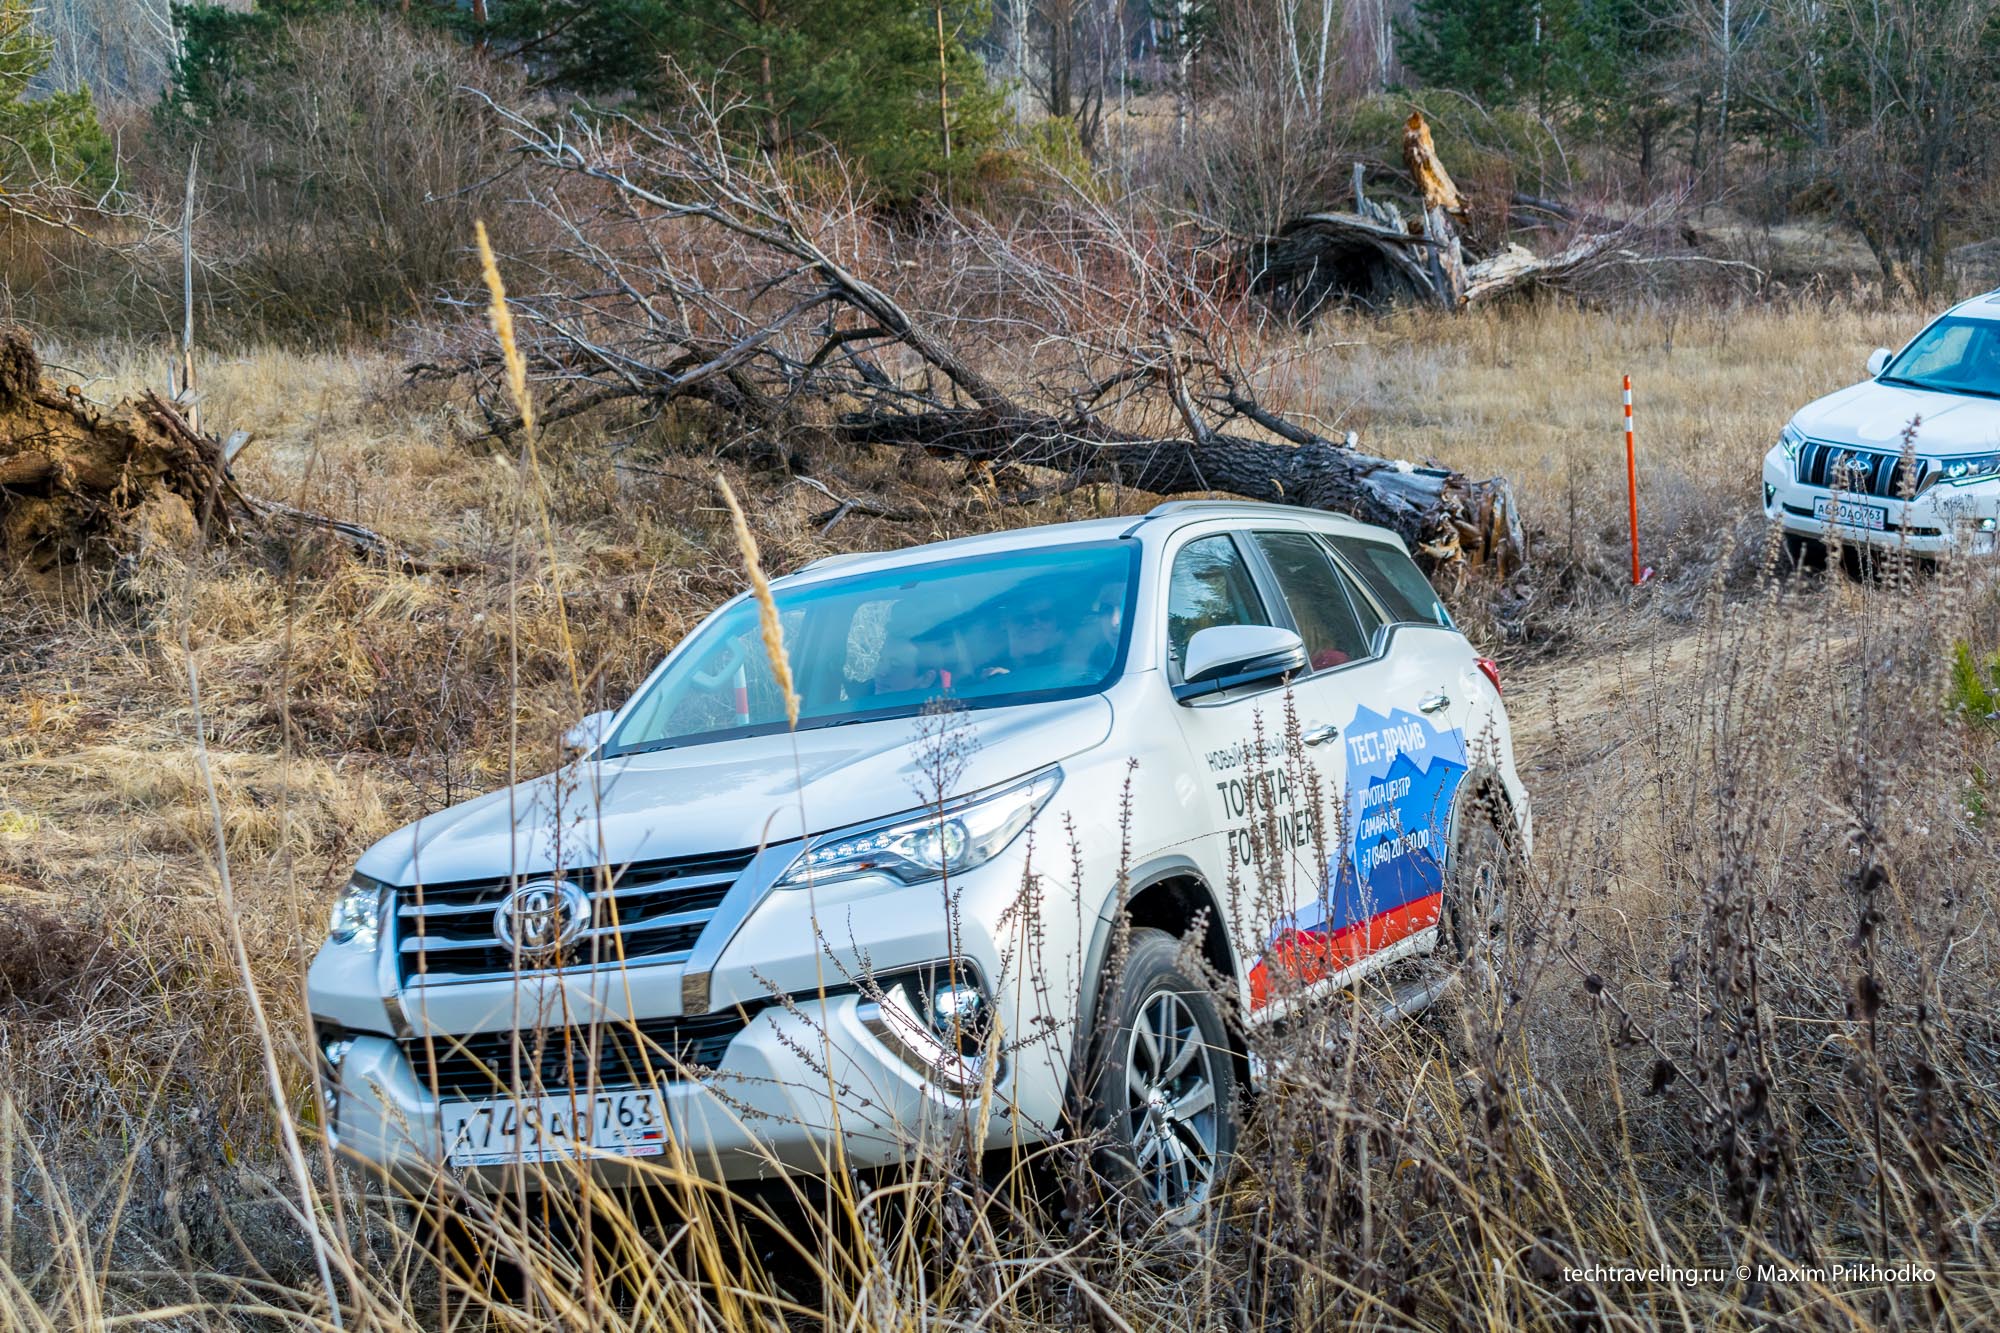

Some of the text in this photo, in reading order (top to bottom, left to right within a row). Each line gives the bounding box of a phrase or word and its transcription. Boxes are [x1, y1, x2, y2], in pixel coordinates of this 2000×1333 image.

[1348, 716, 1426, 766] ТЕСТ-ДРАЙВ
[1205, 742, 1243, 772] НОВЫЙ
[1386, 776, 1411, 802] ЦЕНТР
[1360, 812, 1389, 840] САМАРА
[1372, 841, 1391, 869] (846)
